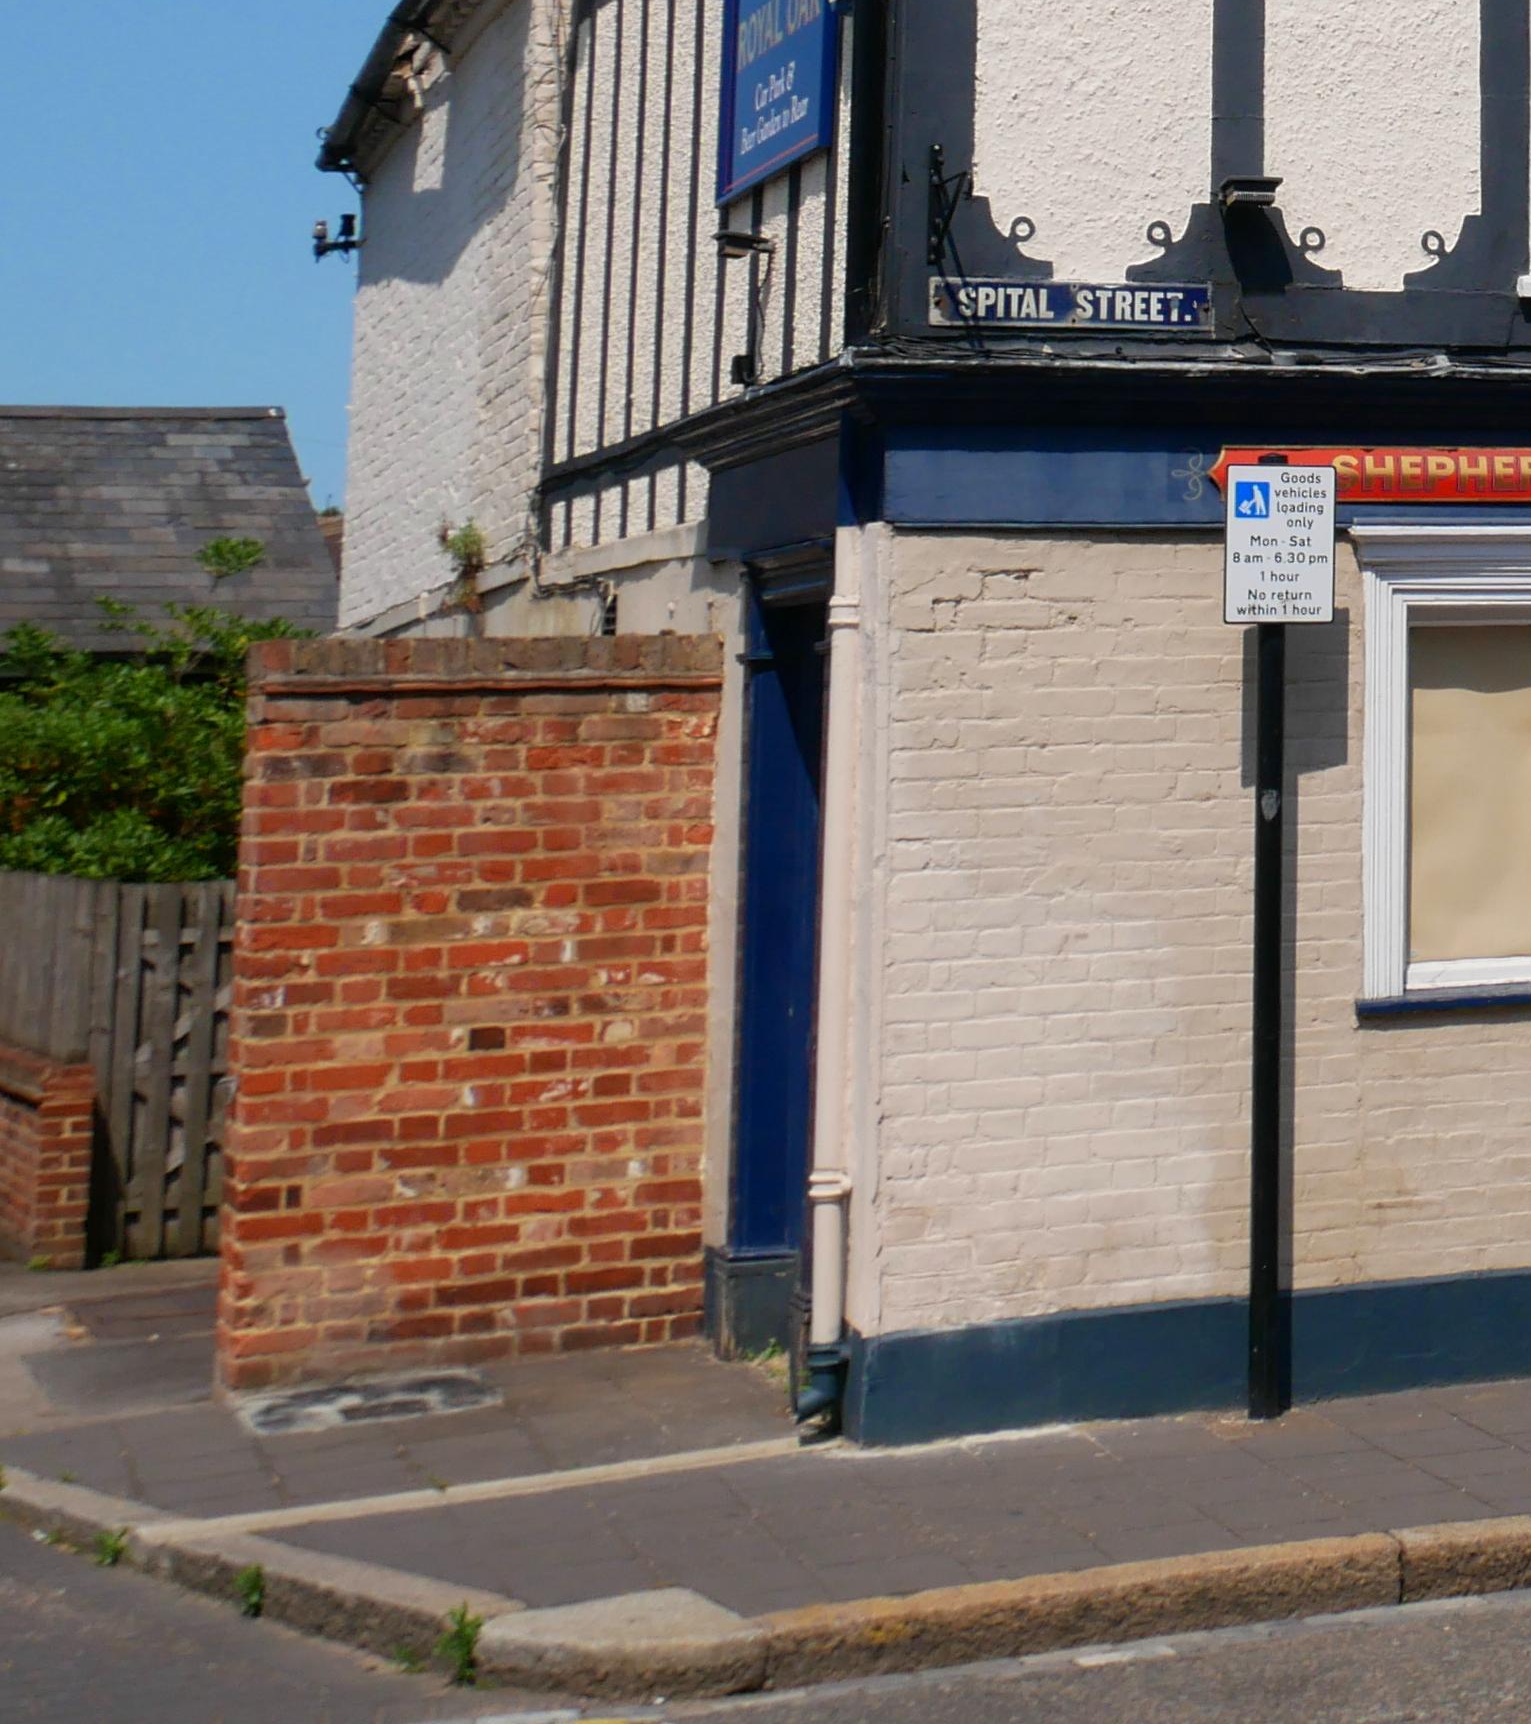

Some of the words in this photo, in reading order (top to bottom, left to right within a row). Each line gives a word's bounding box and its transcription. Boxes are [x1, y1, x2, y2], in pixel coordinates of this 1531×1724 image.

[957, 287, 1054, 318] SPITAL
[1281, 472, 1322, 484] Goods
[1274, 487, 1327, 499] vehicles
[1276, 502, 1325, 515] loading
[1286, 517, 1314, 530] only
[1250, 535, 1279, 547] Mon
[1289, 535, 1312, 547] Sat
[1233, 552, 1241, 564] 8
[1244, 554, 1264, 564] am
[1274, 552, 1305, 564] 6.30
[1308, 554, 1328, 566] pm
[1260, 571, 1265, 582] 1
[1270, 571, 1300, 582] hour
[1248, 589, 1266, 600] No
[1271, 589, 1312, 601] return
[1236, 604, 1277, 616] within
[1282, 605, 1287, 615] 1
[1292, 604, 1322, 616] hour
